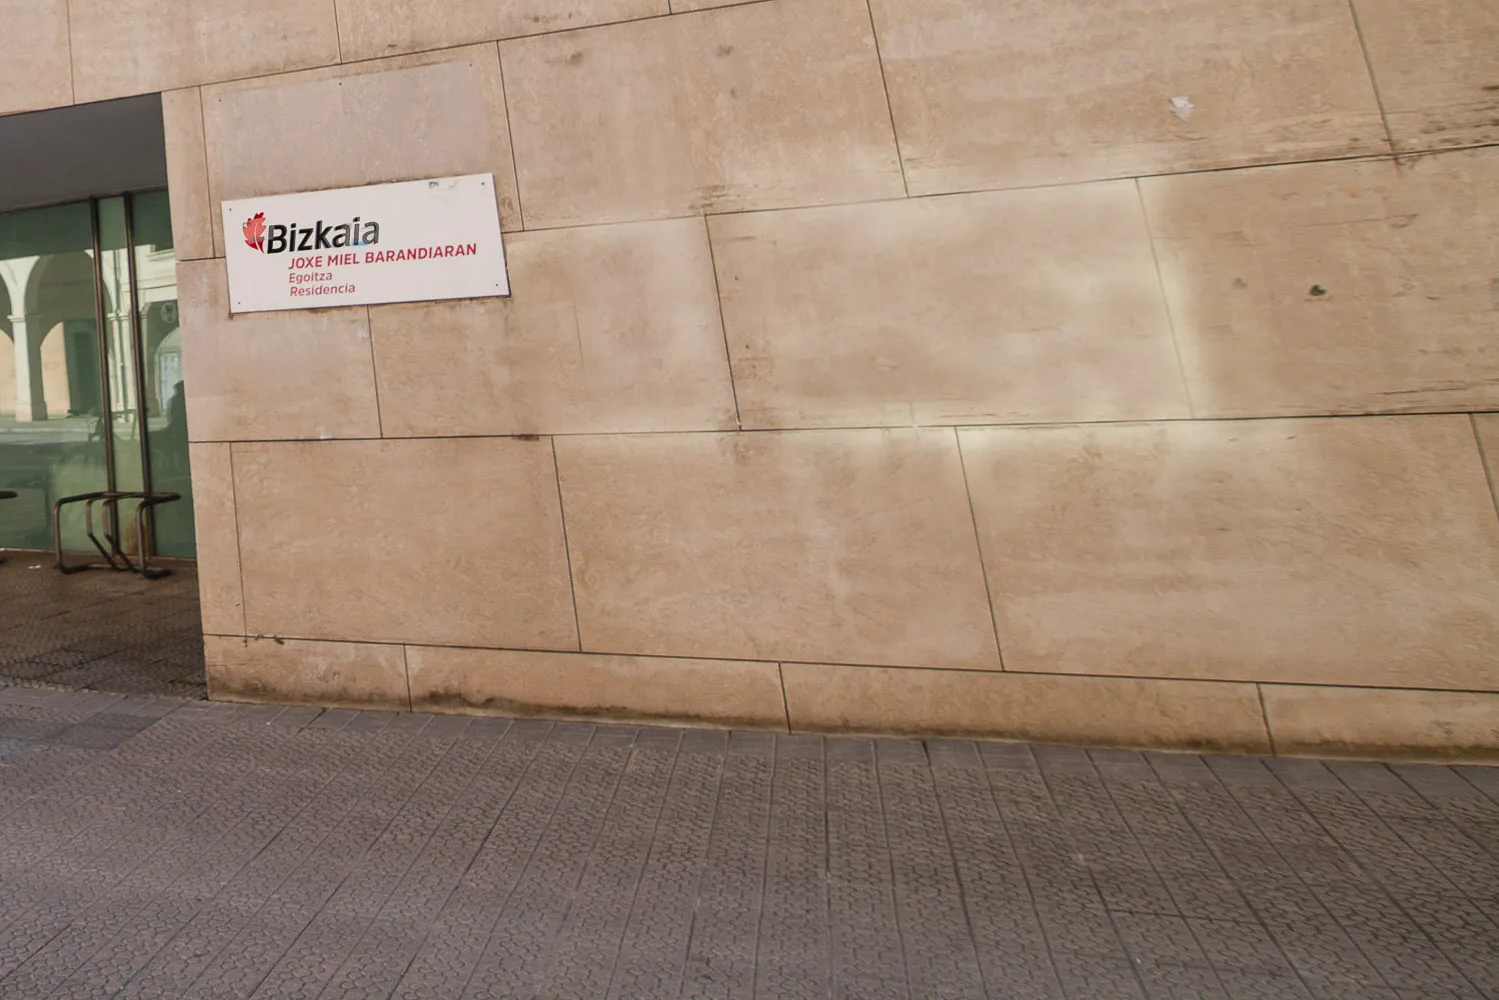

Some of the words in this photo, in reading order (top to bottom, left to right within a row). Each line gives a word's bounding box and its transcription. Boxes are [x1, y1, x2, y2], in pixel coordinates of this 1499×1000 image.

[267, 216, 380, 254] Bizkaia
[288, 255, 323, 270] JOXE
[327, 252, 360, 267] MIEL
[365, 242, 477, 264] BARANDIARAN
[288, 271, 333, 285] Egoitza
[290, 283, 356, 297] Residencia
